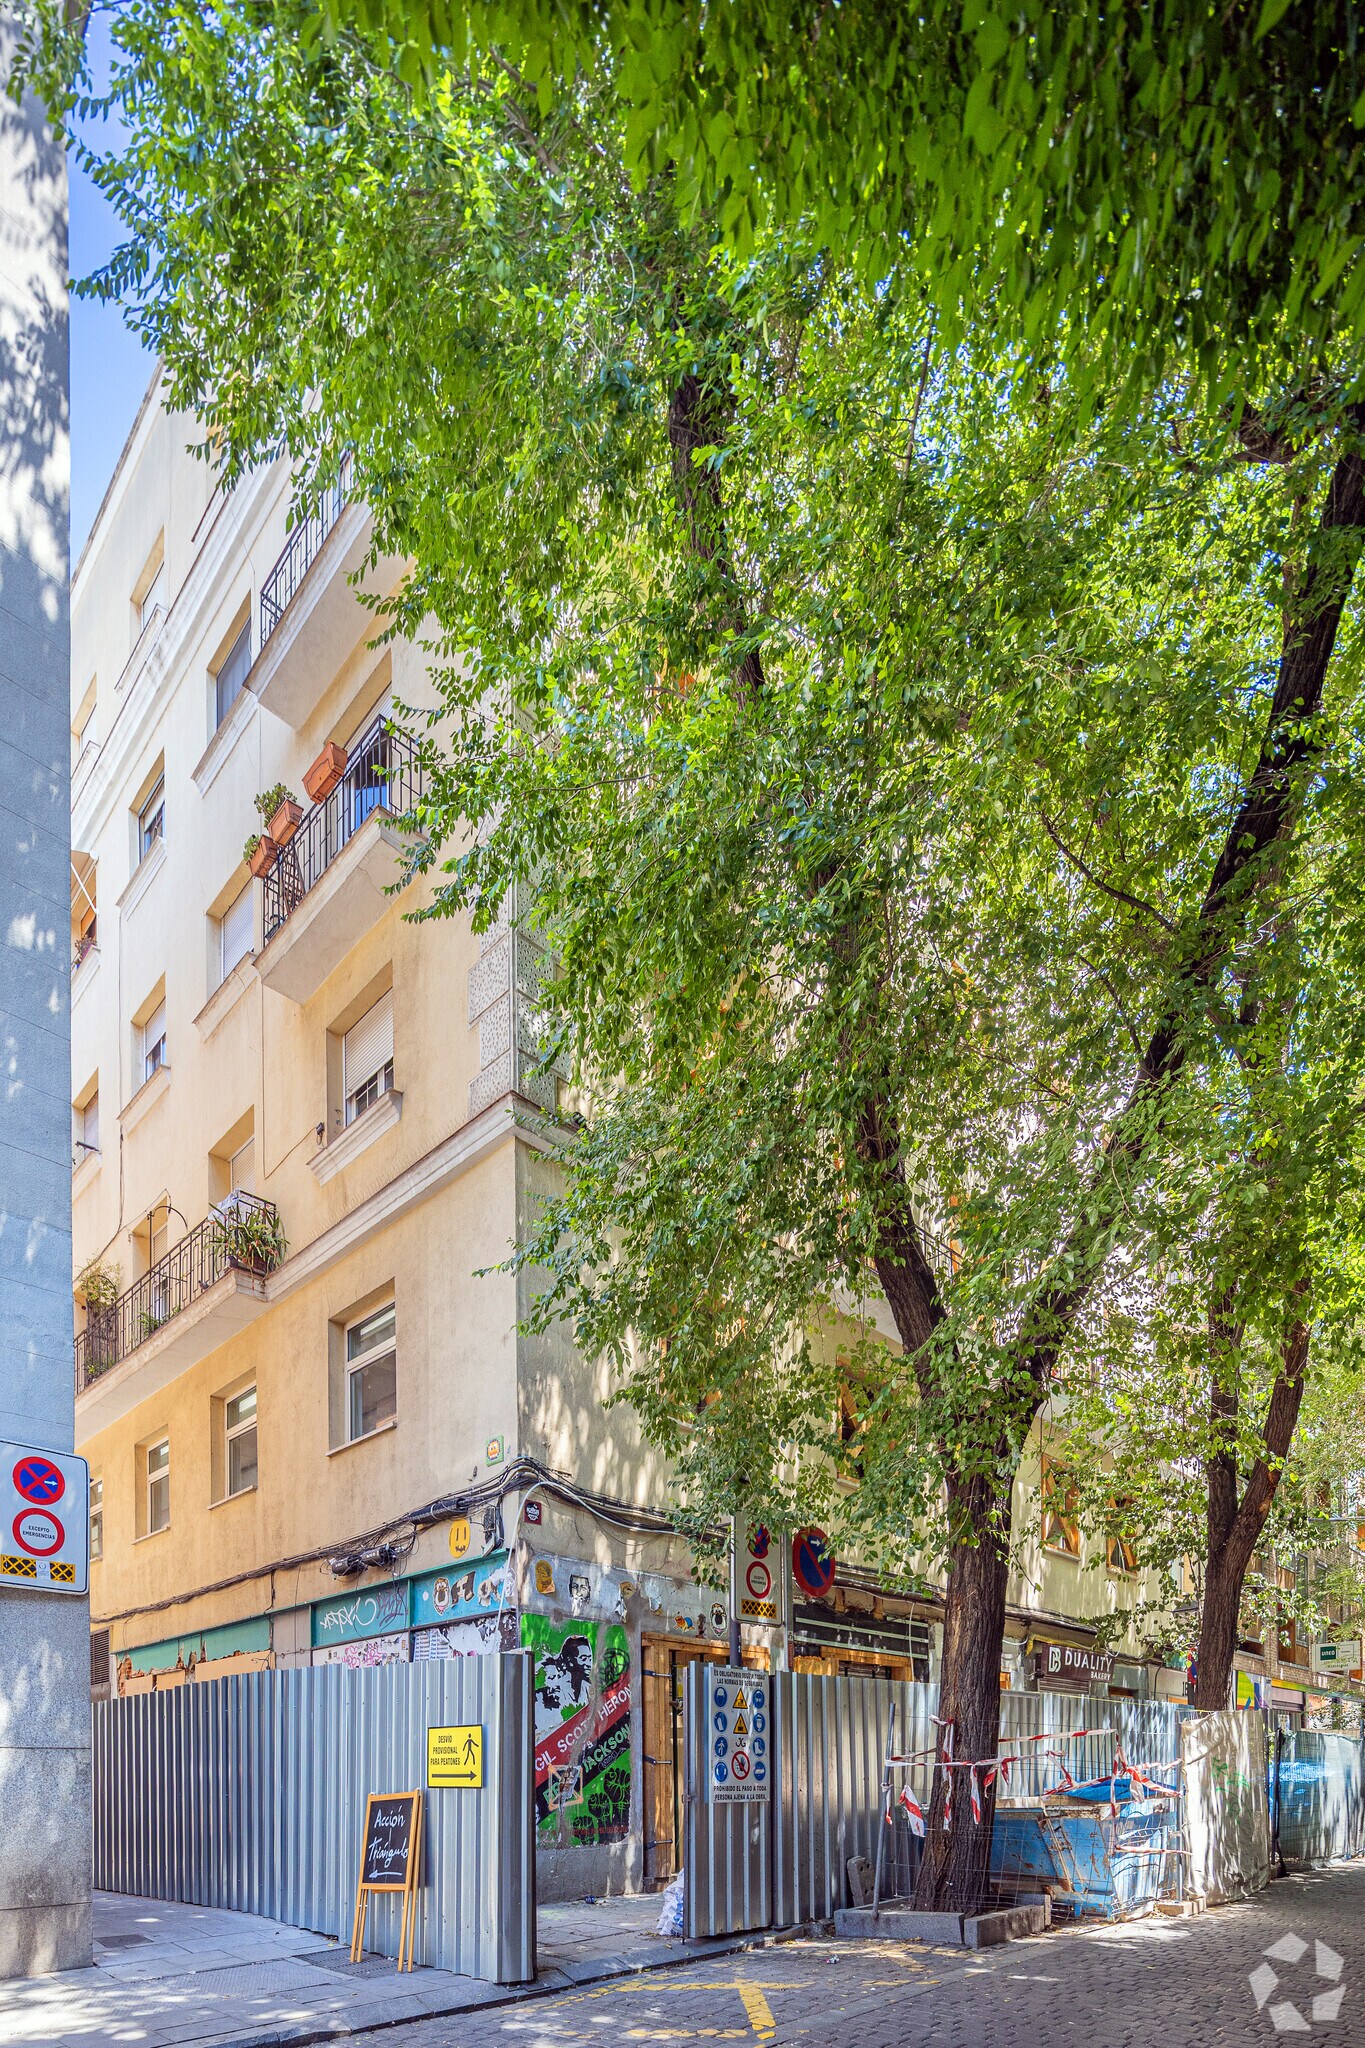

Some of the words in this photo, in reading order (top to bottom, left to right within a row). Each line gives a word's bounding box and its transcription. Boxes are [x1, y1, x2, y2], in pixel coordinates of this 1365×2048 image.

[22, 1530, 55, 1540] EMERGENCIAS
[1064, 1650, 1113, 1672] DUALITY
[1090, 1671, 1112, 1681] BAKERY
[432, 1746, 458, 1754] PROVISIONAL
[582, 1723, 631, 1774] JACKSON
[430, 1757, 440, 1765] PARA
[440, 1757, 461, 1765] PEATONES
[535, 1750, 557, 1771] GIL
[714, 1793, 733, 1801] PERSONA
[374, 1805, 405, 1828] Acción
[368, 1836, 410, 1868] Triángulo
